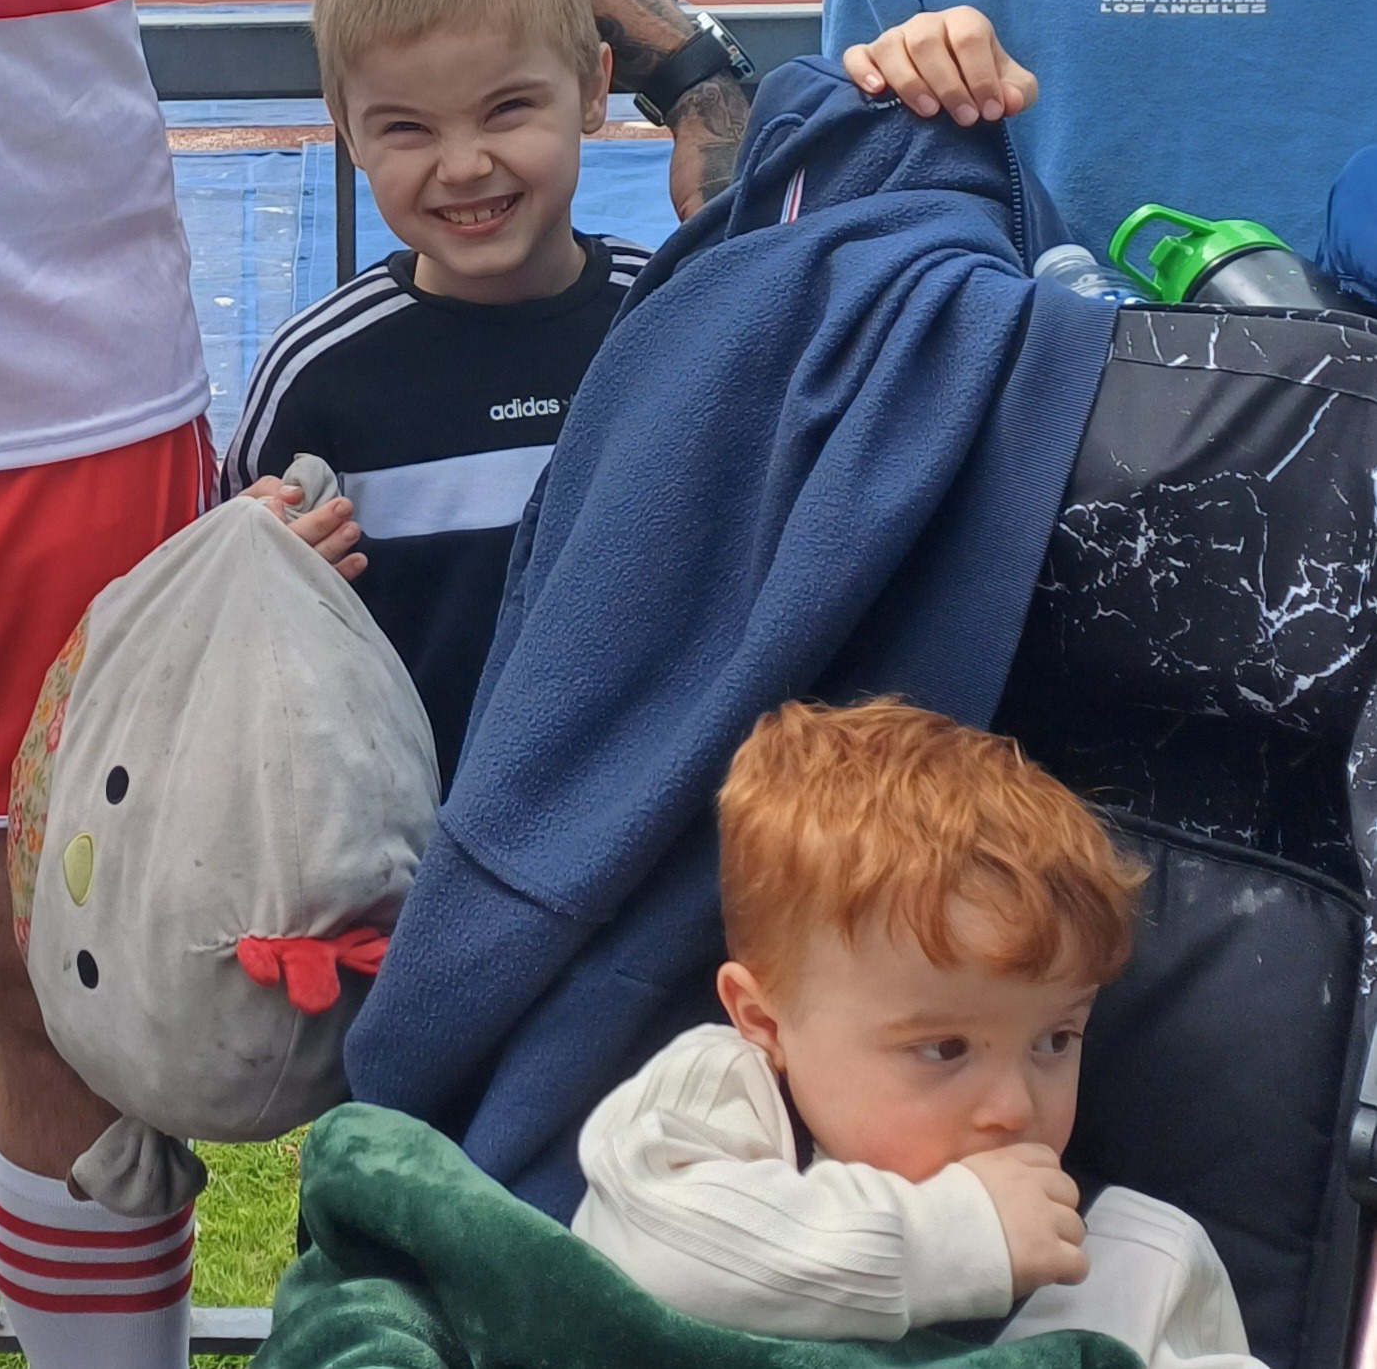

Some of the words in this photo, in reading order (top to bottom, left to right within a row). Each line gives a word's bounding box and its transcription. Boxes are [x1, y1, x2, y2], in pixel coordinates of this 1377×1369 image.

[1099, 3, 1146, 14] LOS
[1152, 3, 1267, 15] ANGELES
[489, 396, 560, 421] adidas
